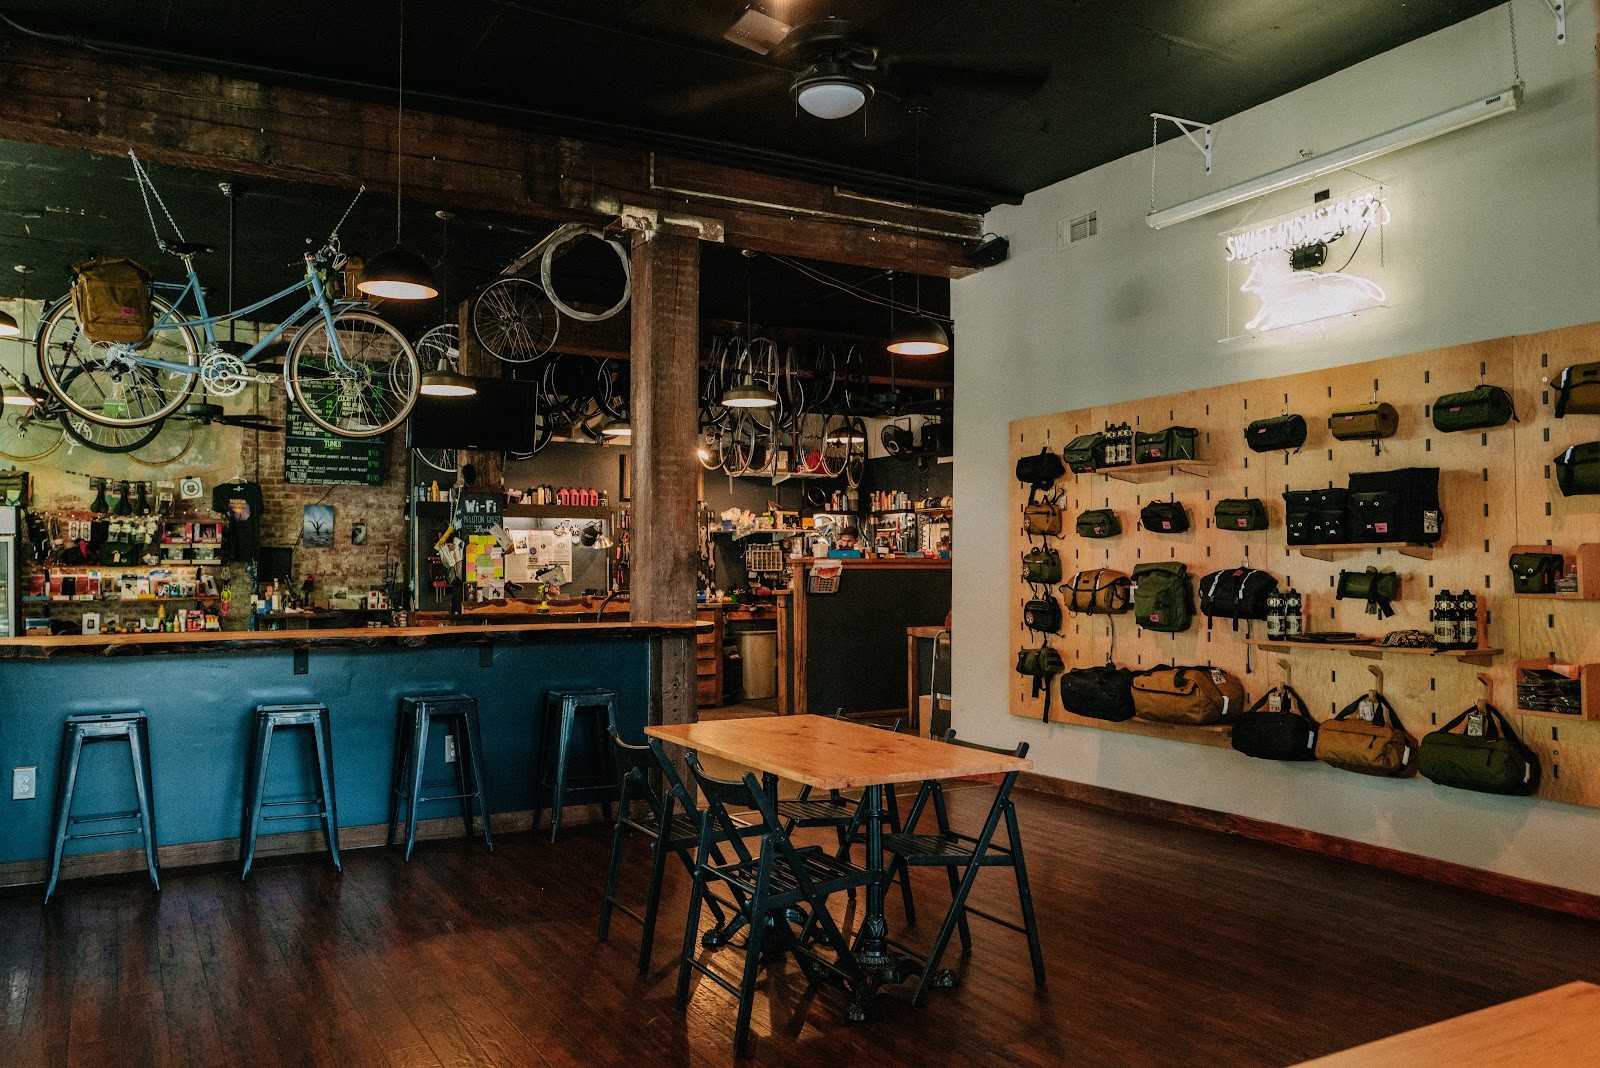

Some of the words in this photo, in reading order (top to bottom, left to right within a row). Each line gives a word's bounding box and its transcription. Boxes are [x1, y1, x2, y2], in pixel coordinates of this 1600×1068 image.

[324, 439, 342, 448] TUNES
[286, 446, 299, 454] QUICK
[300, 446, 311, 454] TUNE
[286, 458, 298, 466] BASIC
[299, 459, 311, 467] TUNE
[465, 500, 497, 513] Wi-Fi
[464, 515, 485, 524] PELOTON
[486, 515, 501, 524] GUEST
